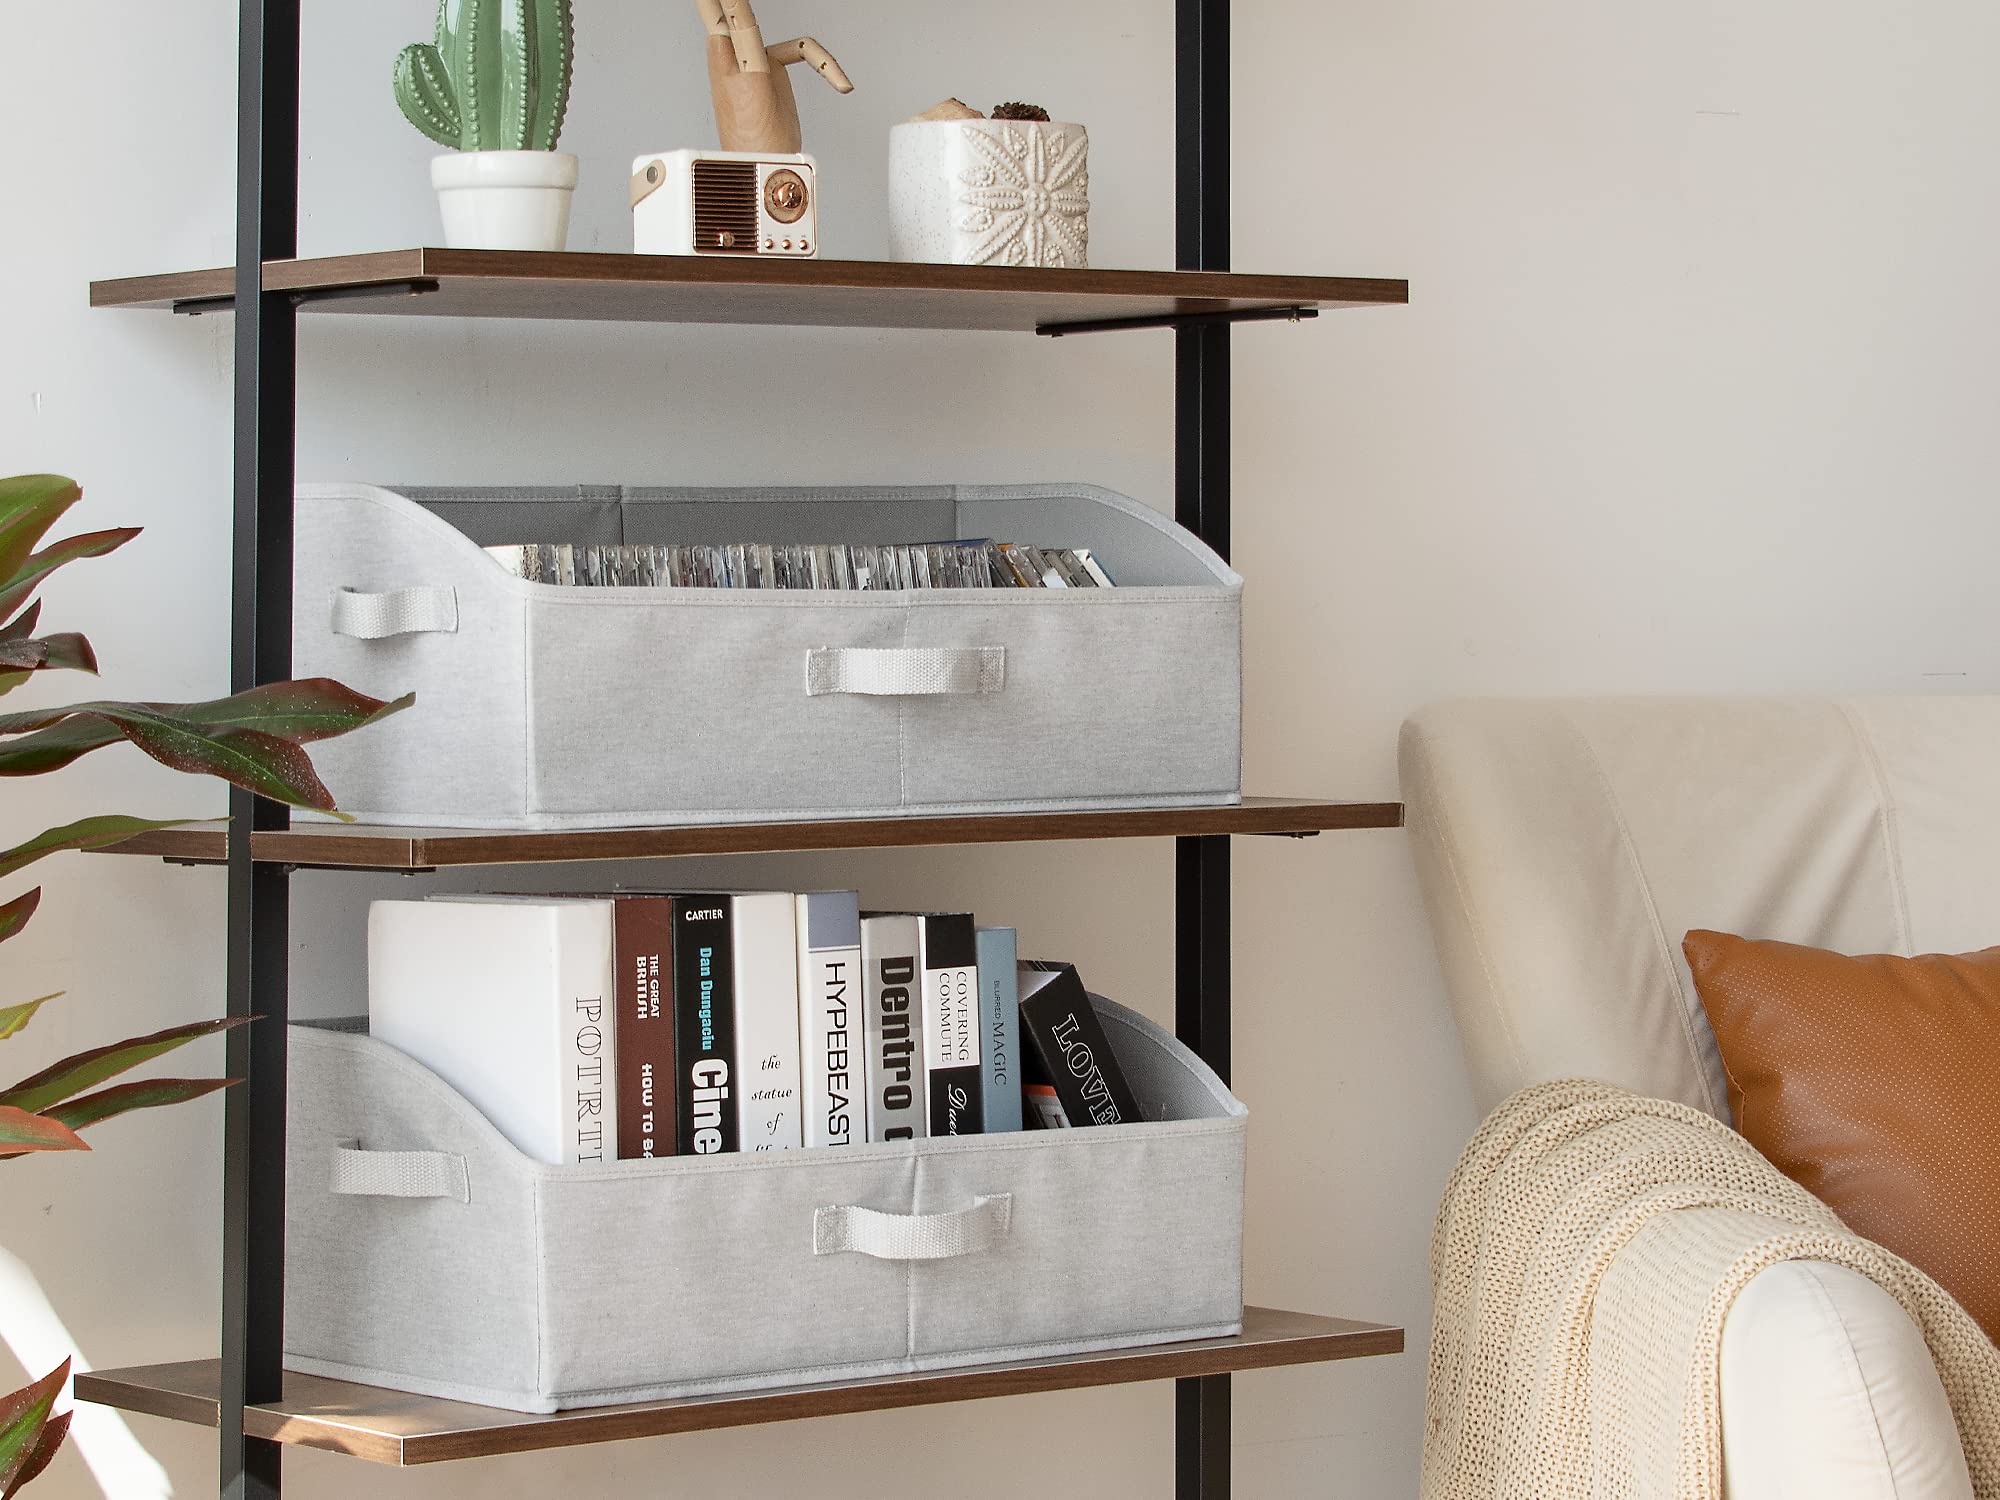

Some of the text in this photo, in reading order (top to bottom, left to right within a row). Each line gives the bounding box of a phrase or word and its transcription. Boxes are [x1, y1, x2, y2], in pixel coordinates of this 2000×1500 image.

[685, 909, 723, 921] CARTIER
[636, 956, 648, 1019] BRITISH
[649, 954, 660, 1018] THE GREAT
[698, 947, 714, 1050] Dan Dungaciu
[939, 972, 952, 1063] COMMUTE
[956, 971, 970, 1062] COVERING
[761, 1054, 781, 1071] the
[825, 962, 850, 1147] HYPEBEAST
[880, 956, 915, 1111] Dentro
[992, 1022, 1007, 1086] MAGIC
[642, 1063, 653, 1107] HOW
[751, 1087, 792, 1101] statue
[1051, 1013, 1122, 1127] LOVE
[642, 1110, 653, 1133] TO
[691, 1058, 729, 1154] Cine
[766, 1112, 784, 1136] of
